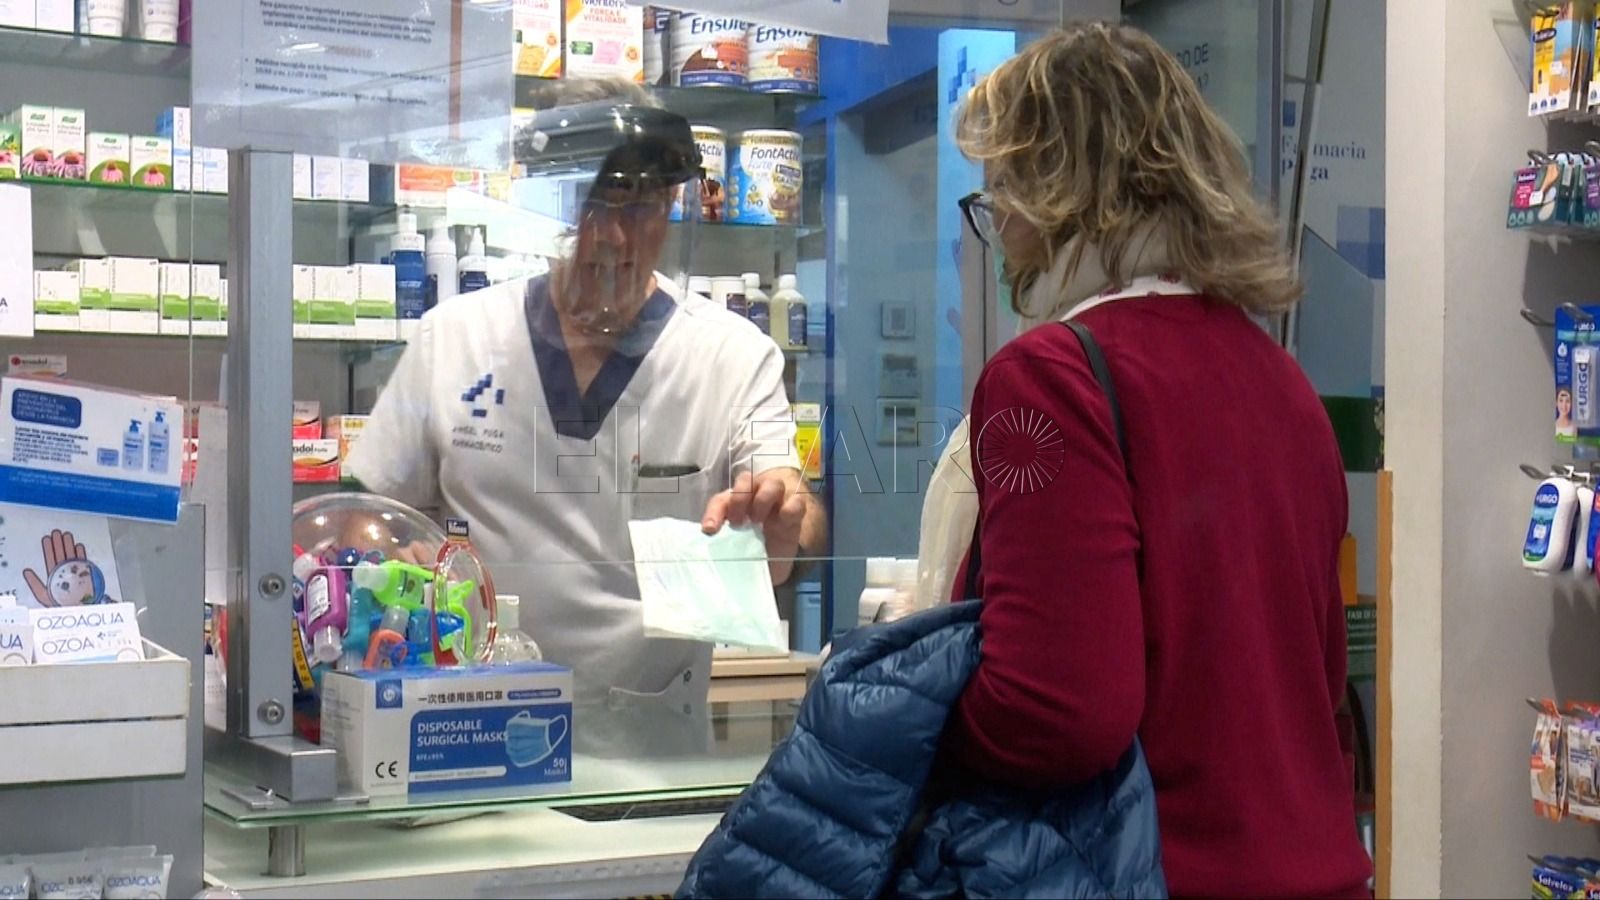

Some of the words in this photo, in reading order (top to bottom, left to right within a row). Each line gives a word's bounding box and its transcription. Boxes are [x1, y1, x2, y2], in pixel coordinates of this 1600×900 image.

[583, 14, 627, 24] VITALIDADE
[1193, 42, 1209, 66] DE
[751, 147, 800, 161] FontActiv
[1282, 135, 1367, 160] Fmacia
[1281, 158, 1329, 186] Pga
[1539, 494, 1558, 504] URGO
[37, 611, 125, 631] OZOAQUA
[417, 719, 483, 734] DISPOSABLE
[416, 734, 470, 748] SURGICAL
[472, 730, 509, 745] MASKS
[375, 760, 399, 779] CE
[553, 757, 565, 769] 50
[107, 876, 162, 888] OZOAQUA
[1538, 873, 1574, 892] Salvelox
